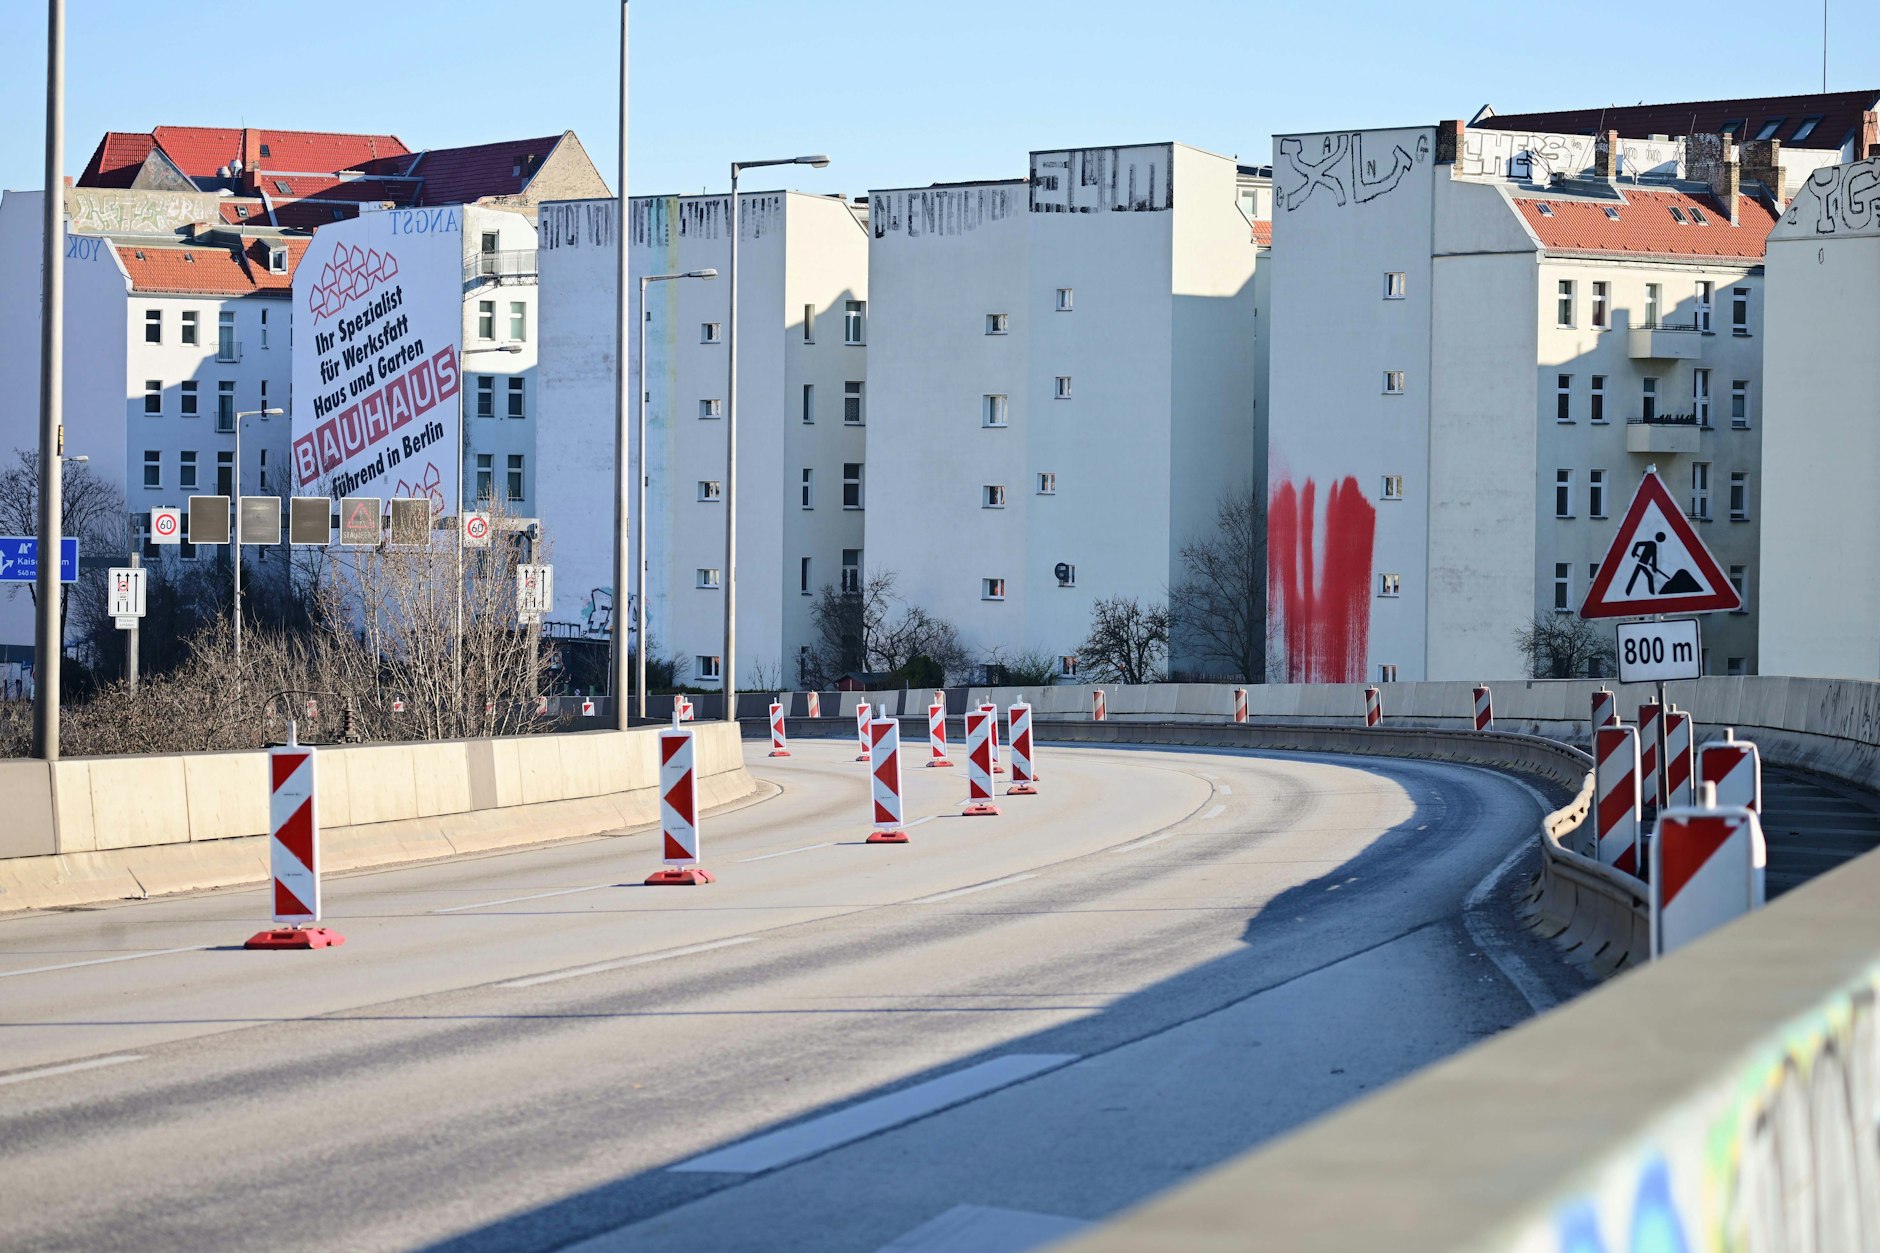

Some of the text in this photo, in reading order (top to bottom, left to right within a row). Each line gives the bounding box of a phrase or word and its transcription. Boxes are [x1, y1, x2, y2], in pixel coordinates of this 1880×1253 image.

[315, 285, 402, 356] Ihr Spezialist
[320, 313, 409, 385] für Werkstatt
[313, 338, 424, 419] Haus und Garten
[296, 353, 458, 482] BAUHAUS
[332, 421, 444, 500] führend in Berlin
[160, 519, 173, 530] 60
[471, 523, 484, 533] 60
[1624, 637, 1692, 665] 800 m
